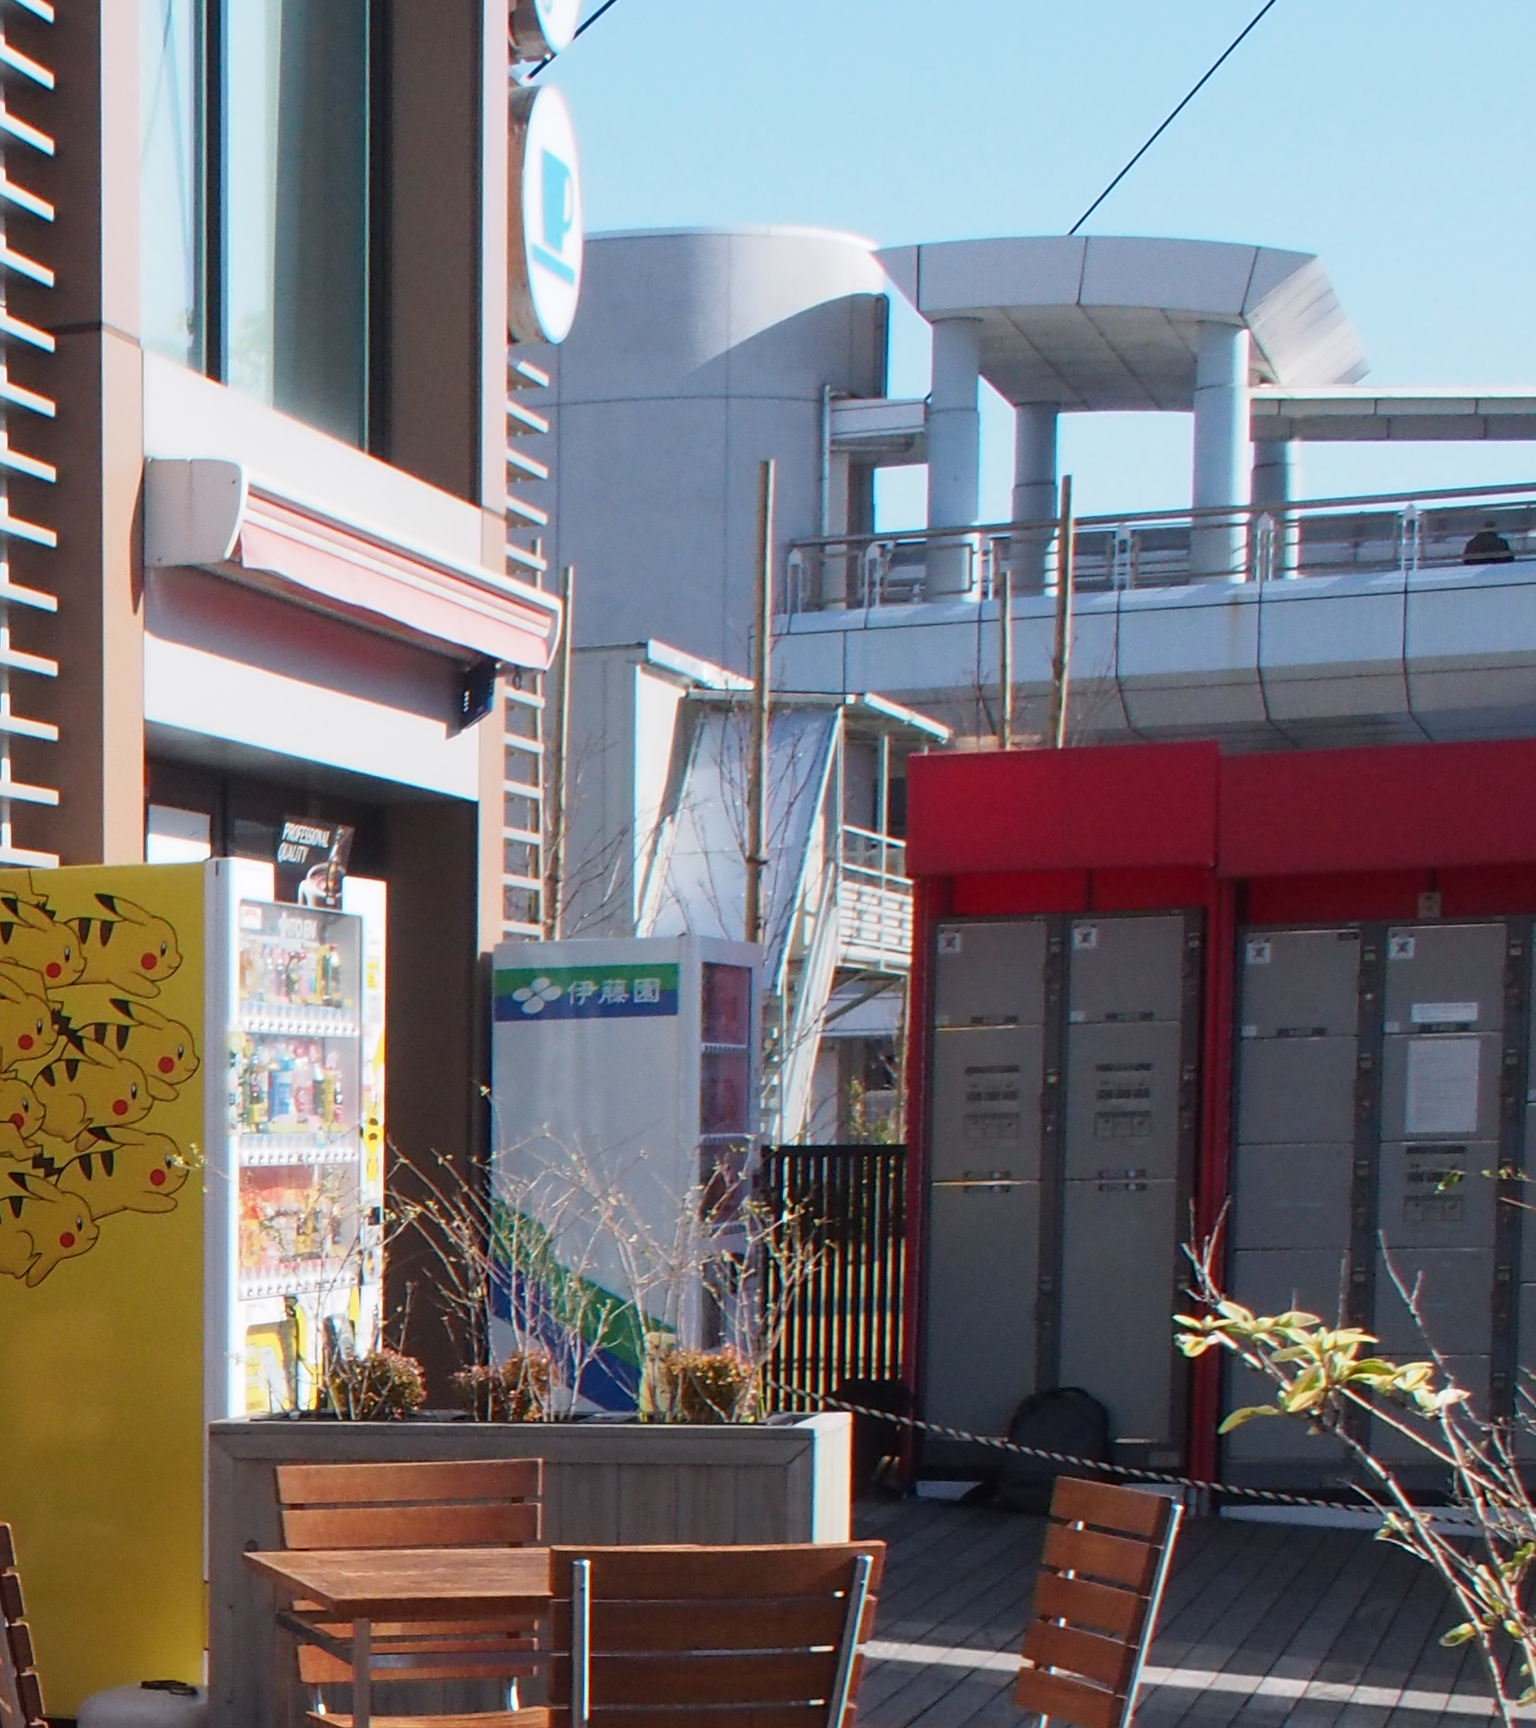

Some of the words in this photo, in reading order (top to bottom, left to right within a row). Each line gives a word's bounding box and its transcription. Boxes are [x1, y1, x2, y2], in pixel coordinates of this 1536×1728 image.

[282, 821, 330, 848] PROFESSIONAL
[278, 842, 310, 863] QUALITY
[567, 977, 661, 1006] 伊藤園
